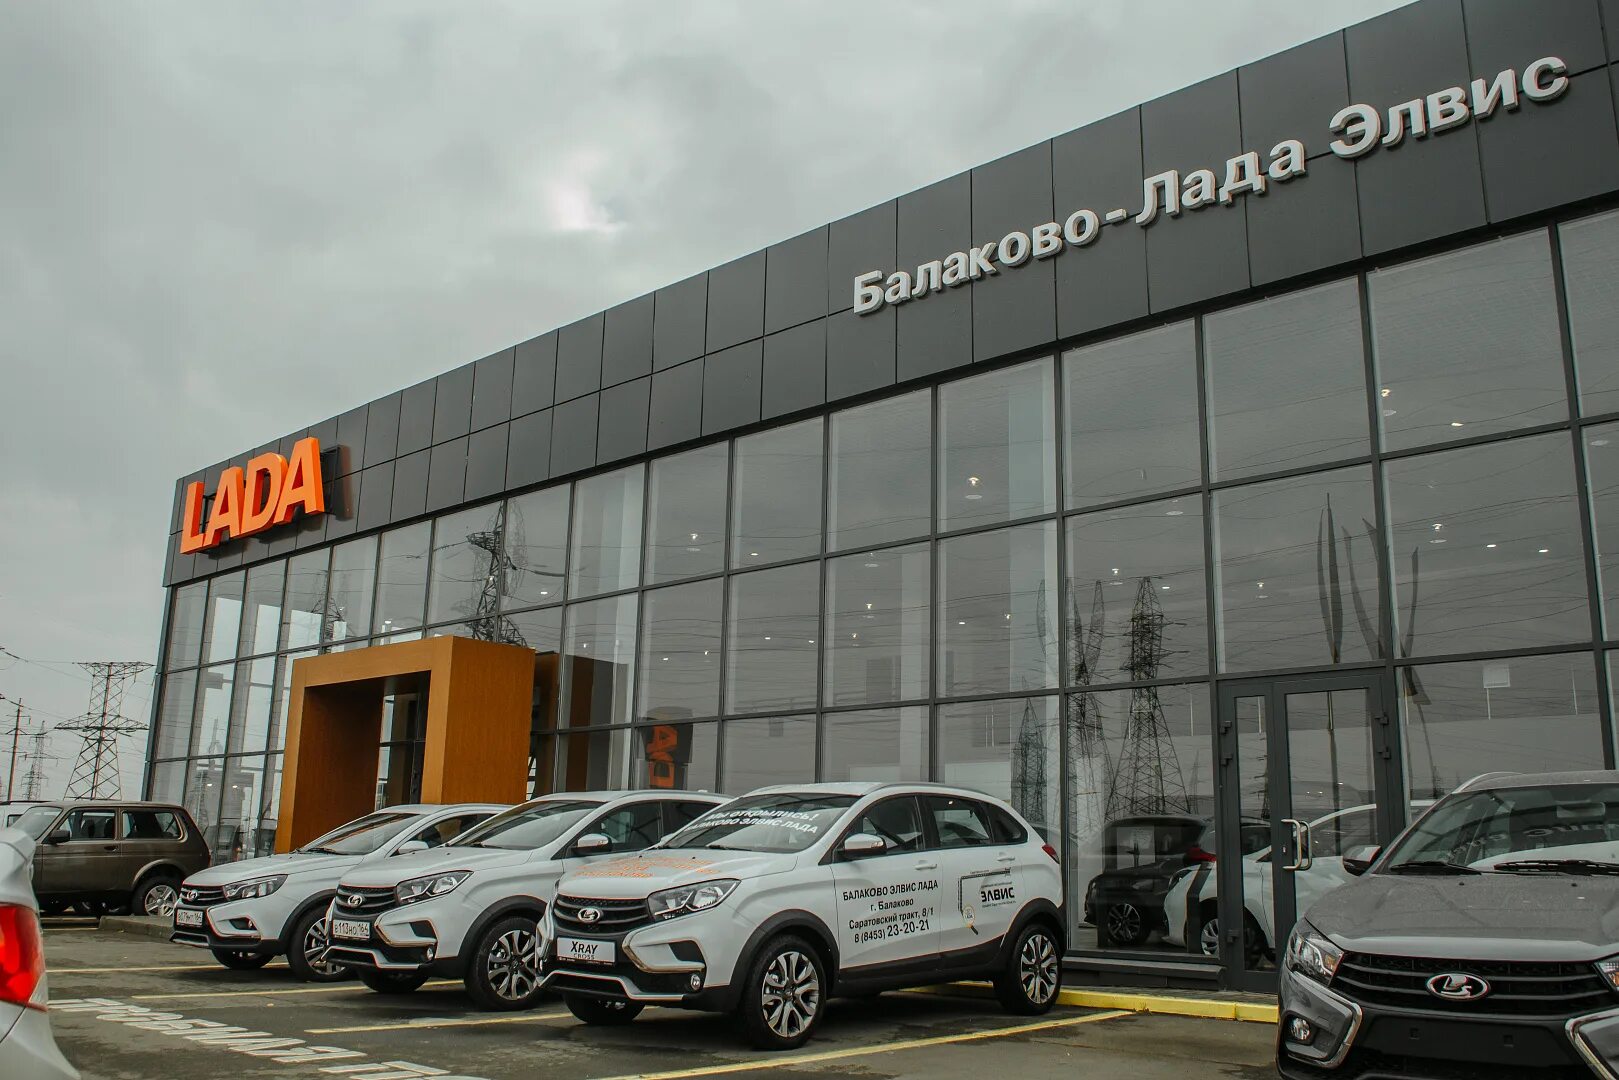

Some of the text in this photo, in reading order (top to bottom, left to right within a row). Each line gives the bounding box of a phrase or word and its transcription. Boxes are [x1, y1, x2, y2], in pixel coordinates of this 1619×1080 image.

[852, 56, 1569, 316] Балаково-Лада Элвис
[180, 437, 325, 554] LADA
[780, 820, 818, 834] ЛАДА
[843, 879, 939, 901] БАЛАКОВО ЭЛВИС ЛАДА
[870, 898, 914, 912] г. Балаково
[849, 913, 898, 930] Саратовский
[921, 906, 934, 917] 8/1
[854, 919, 930, 943] 8 (8453) 23-20-21
[571, 941, 598, 954] XRAY
